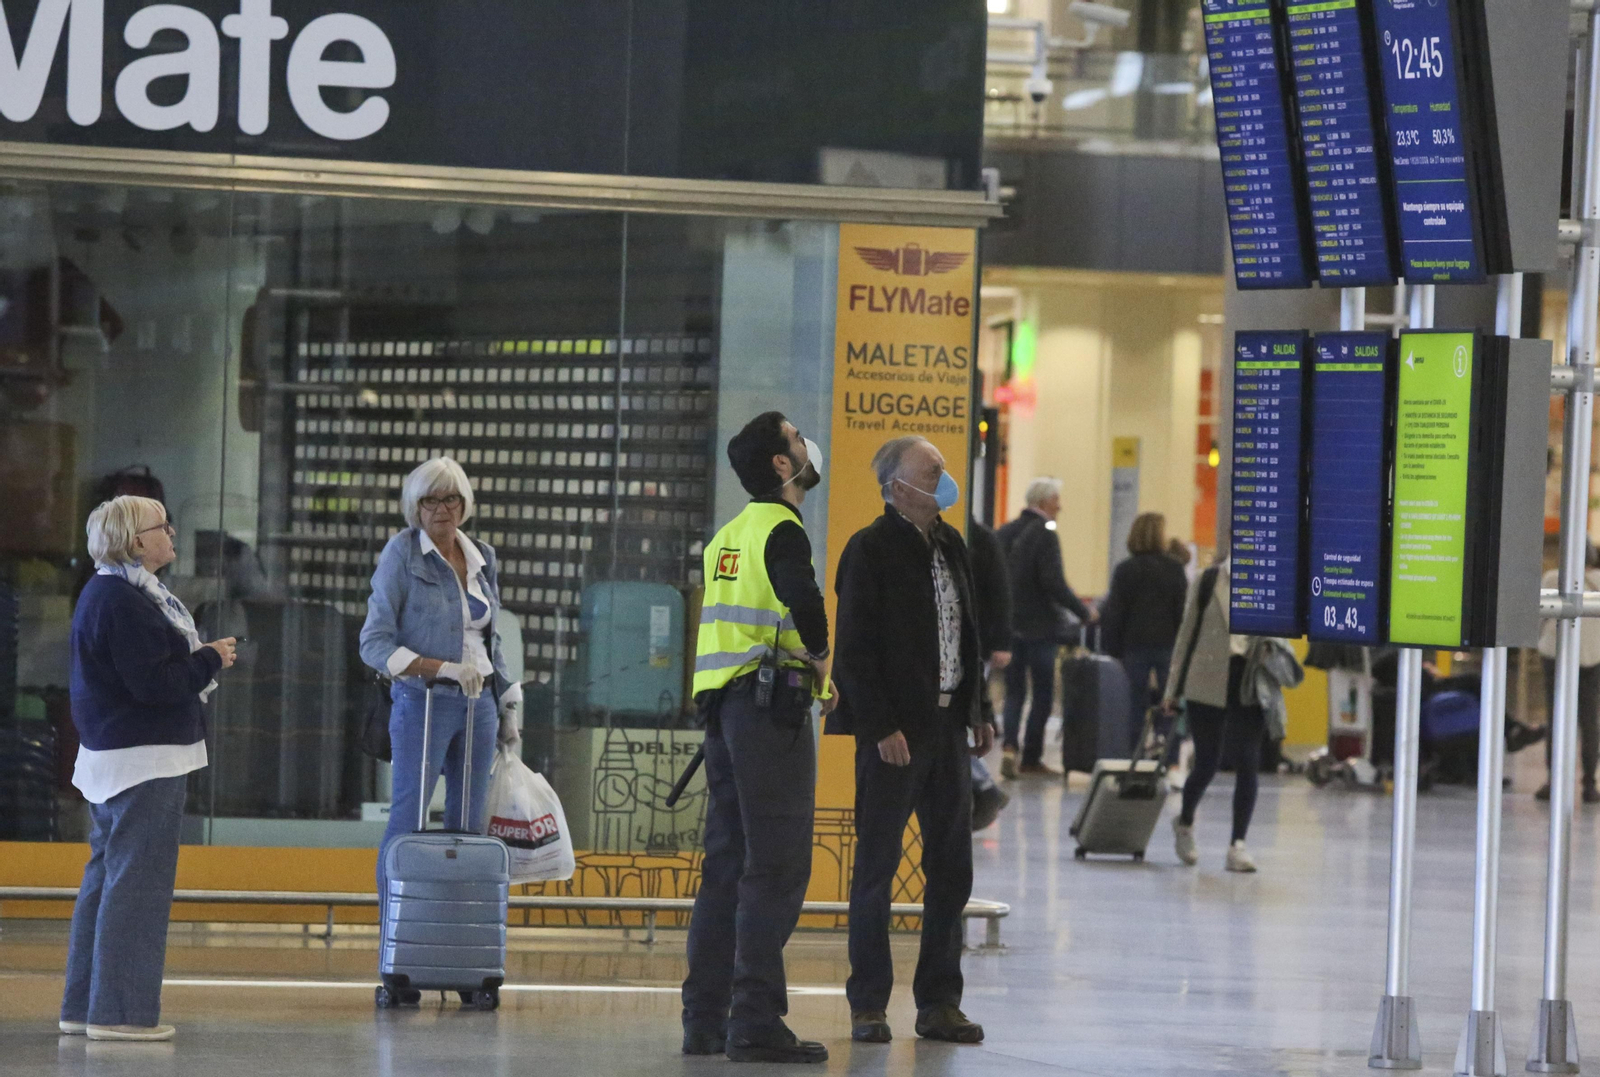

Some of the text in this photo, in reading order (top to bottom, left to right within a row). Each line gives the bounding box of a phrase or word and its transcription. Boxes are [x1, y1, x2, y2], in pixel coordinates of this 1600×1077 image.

[1392, 36, 1444, 79] 12:45
[1432, 128, 1455, 146] 50,3%
[1403, 202, 1423, 214] Mantenga
[1423, 201, 1440, 213] siempre
[1446, 200, 1464, 212] equipaje
[1424, 216, 1446, 226] controlado
[849, 284, 970, 317] FLYMate
[846, 341, 968, 369] MALETAS
[1273, 344, 1296, 354] SALIDAS
[1354, 346, 1378, 356] SALIDAS
[847, 368, 968, 386] Accesorios de Viaje
[844, 391, 966, 418] LUGGAGE
[846, 417, 964, 434] Travel Accesories
[1343, 554, 1361, 563] seguridad
[1324, 577, 1337, 586] Tiempo
[1338, 578, 1354, 586] estimado
[1324, 605, 1336, 627] 03
[1345, 606, 1358, 628] 43
